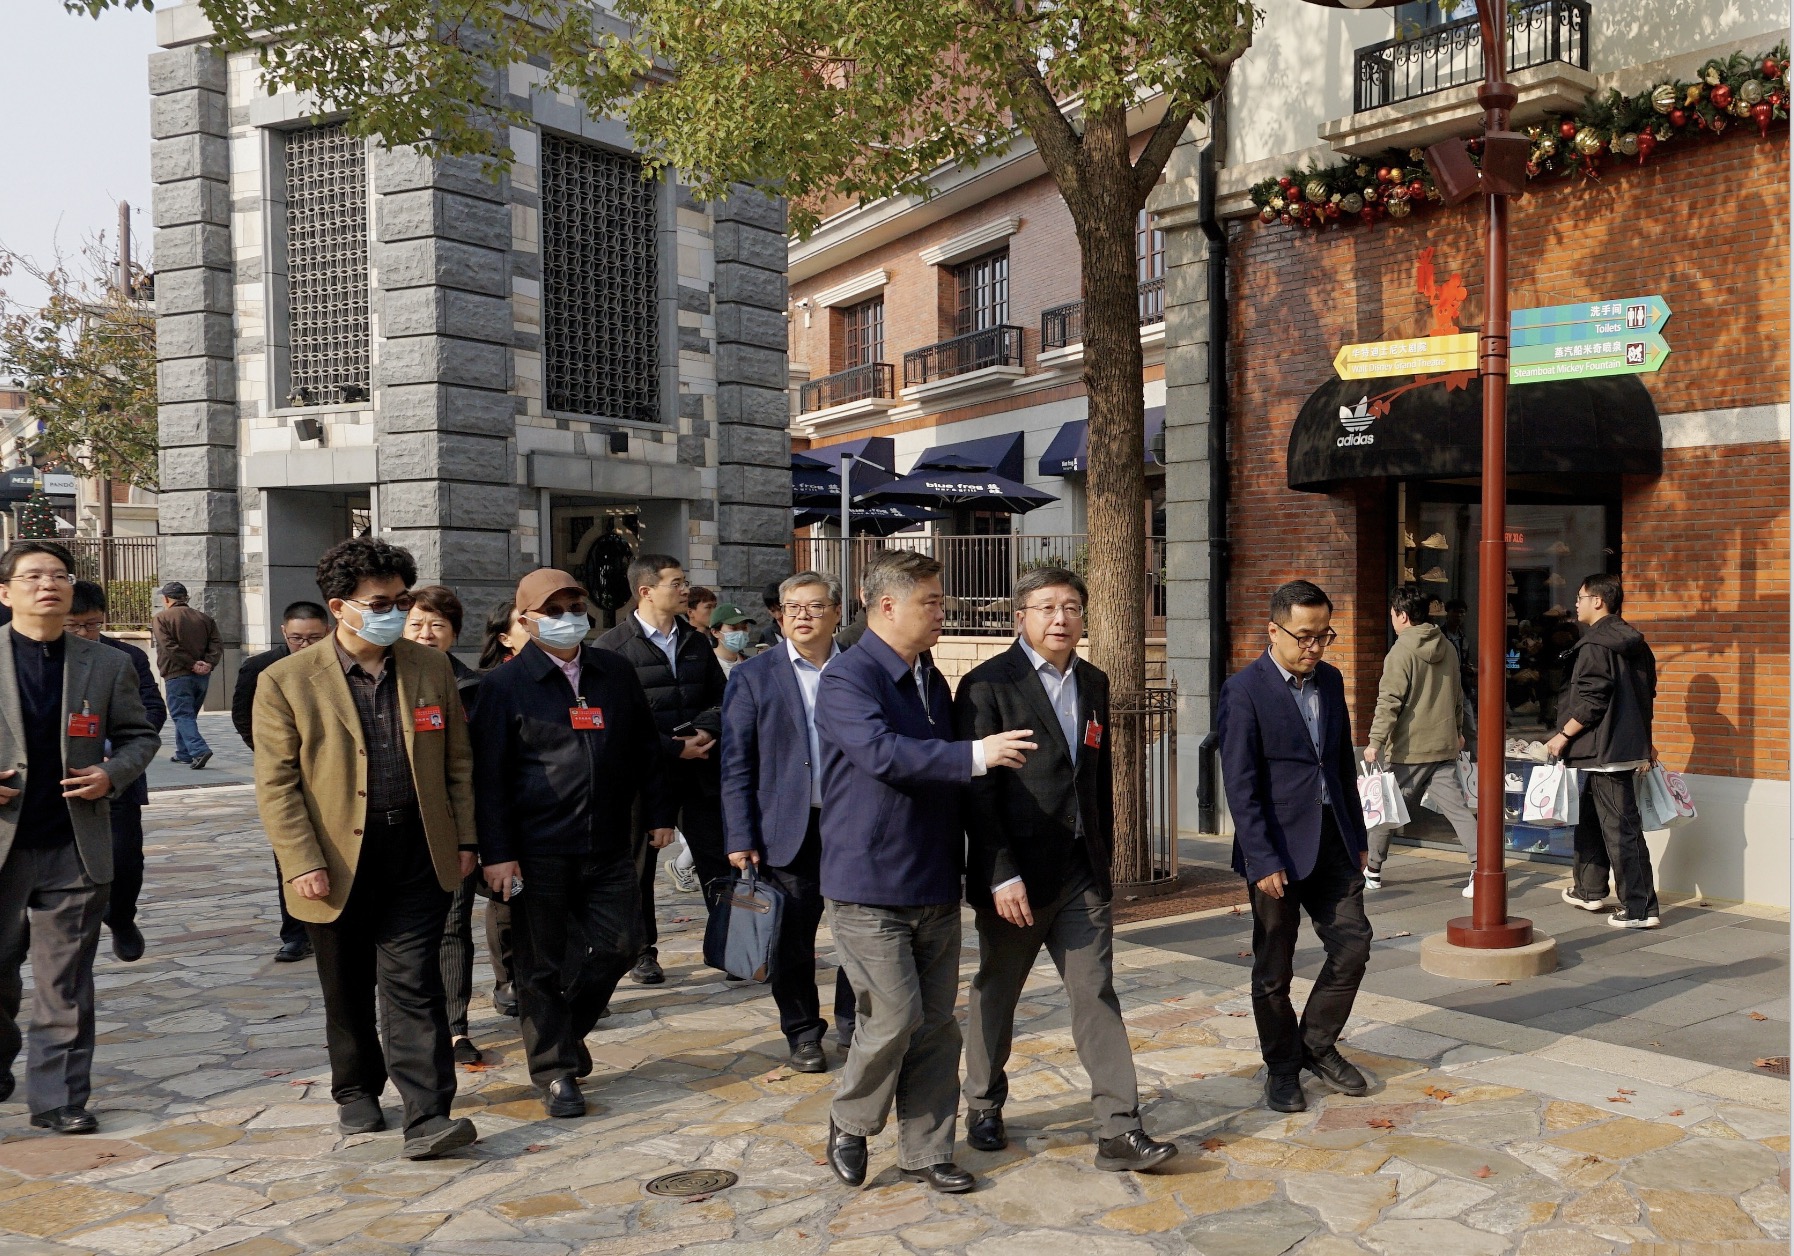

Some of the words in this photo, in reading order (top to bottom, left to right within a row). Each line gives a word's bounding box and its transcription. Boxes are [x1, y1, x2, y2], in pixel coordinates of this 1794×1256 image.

[1590, 303, 1622, 317] 洗手间
[1595, 323, 1621, 334] Toilets
[1352, 342, 1427, 357] 华特迪士尼大剧院
[1554, 341, 1622, 358] 蒸汽船米奇喷泉
[1352, 364, 1368, 374] Walt
[1369, 363, 1393, 373] Disney
[1395, 361, 1417, 369] Grand
[1418, 358, 1446, 367] Theatre
[1514, 365, 1555, 378] Steamboat
[1556, 363, 1584, 375] Mickey
[1585, 360, 1621, 370] Fountain
[1337, 433, 1374, 447] adidas
[957, 483, 984, 491] frog
